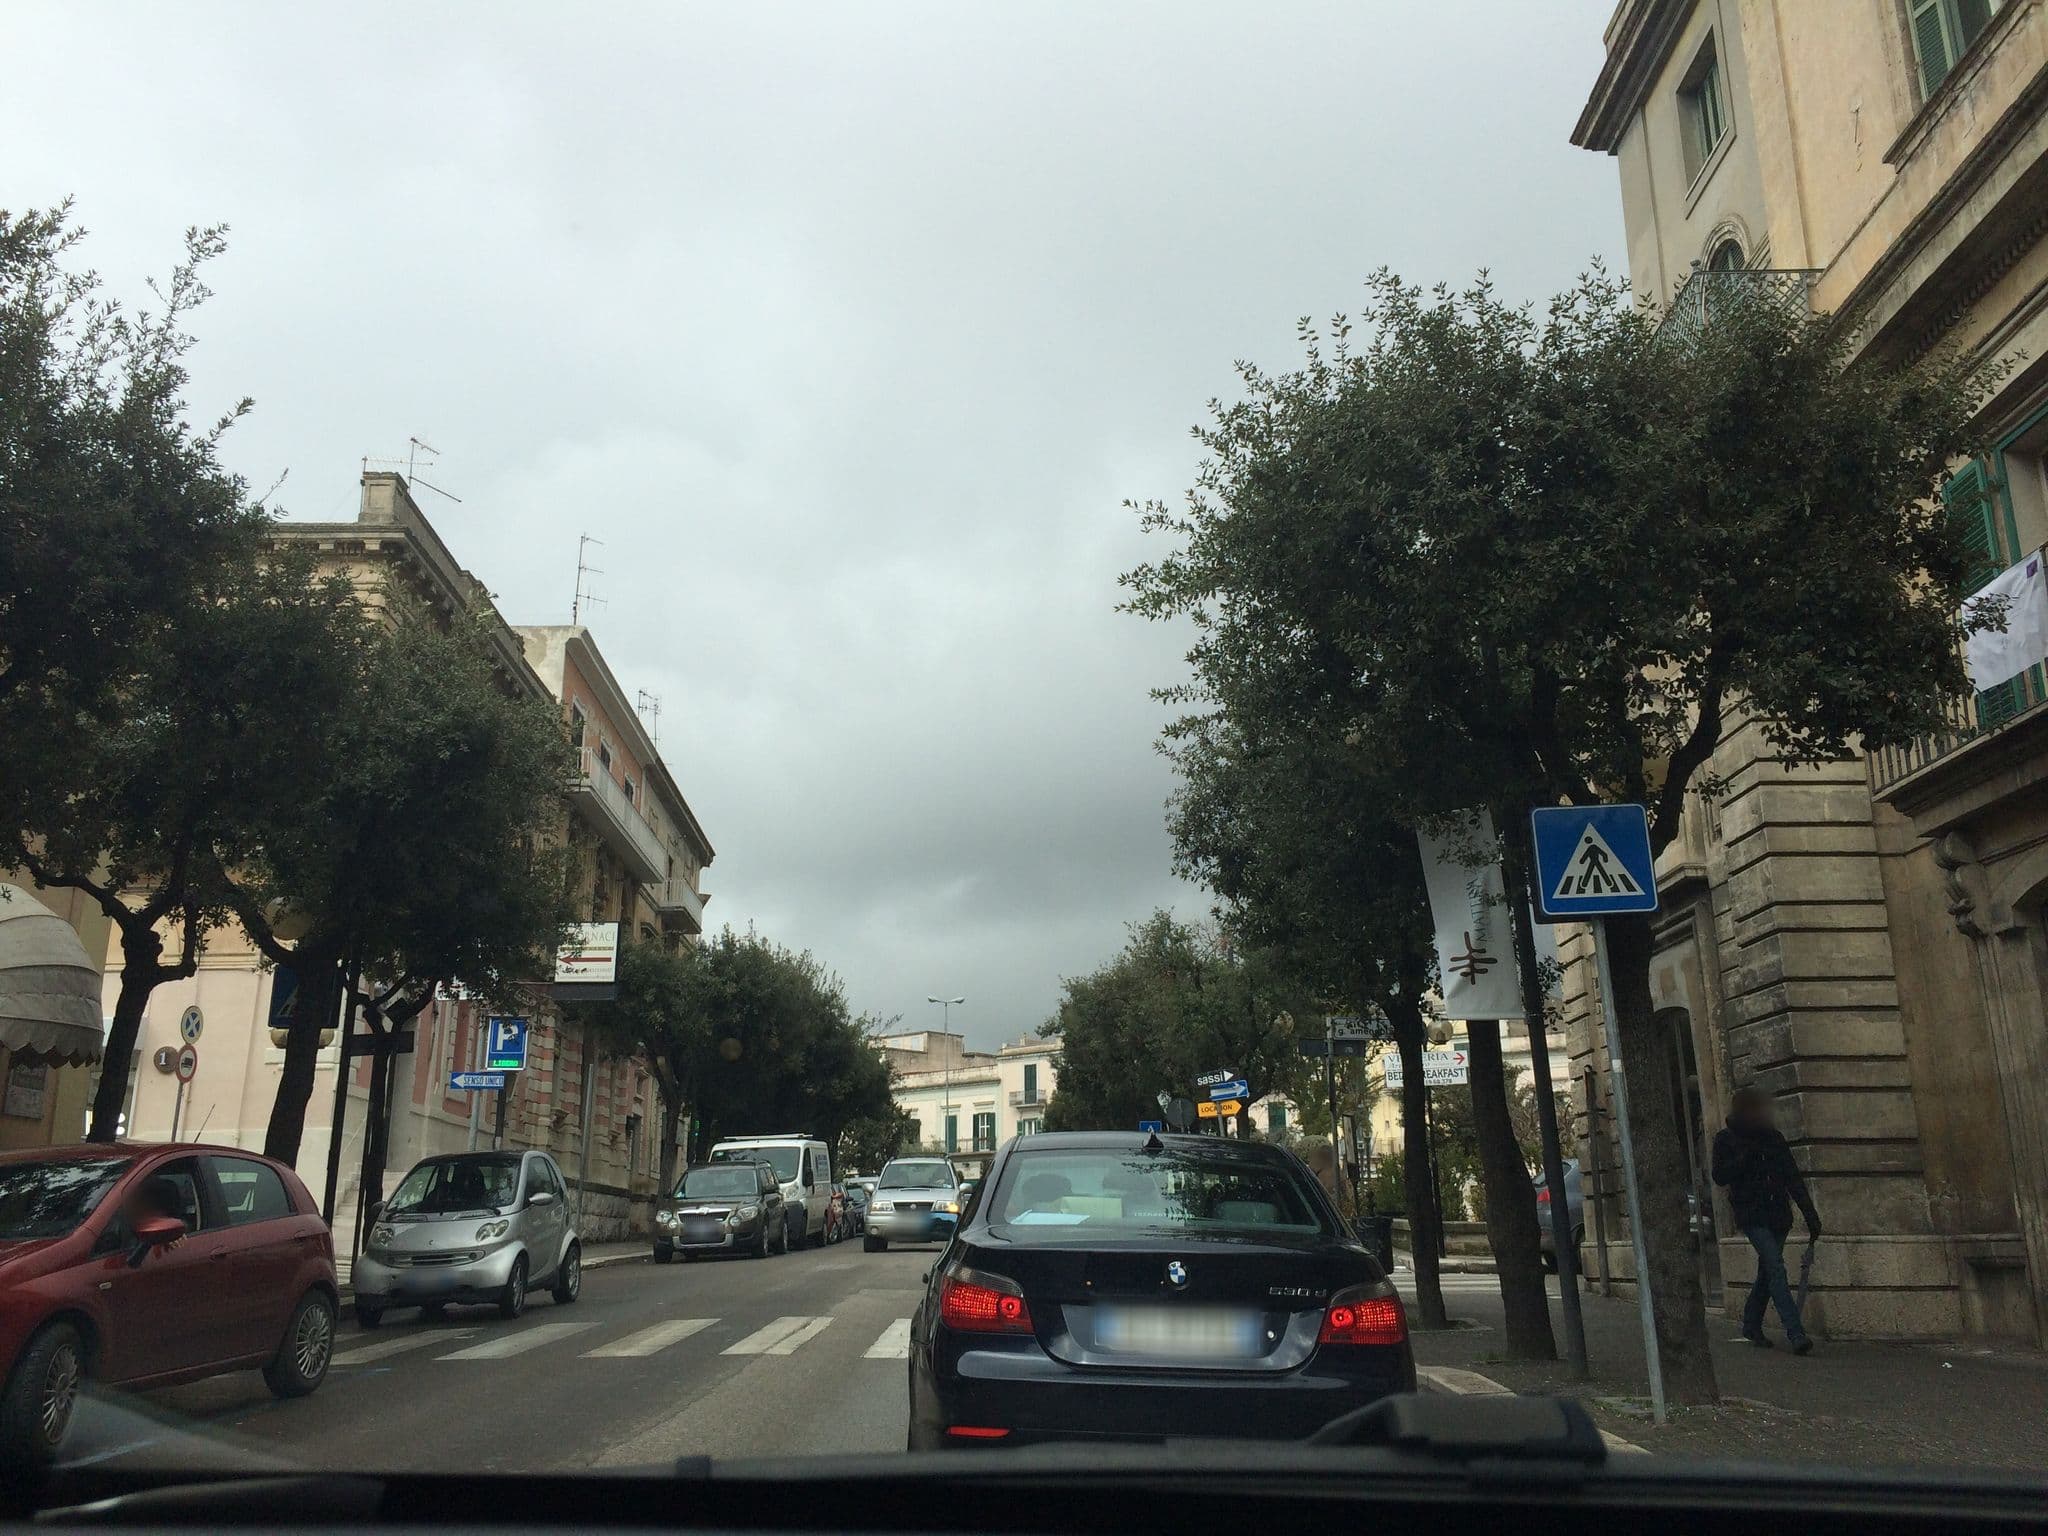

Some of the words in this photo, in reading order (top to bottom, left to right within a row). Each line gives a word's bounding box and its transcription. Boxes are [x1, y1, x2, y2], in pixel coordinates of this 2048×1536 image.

[159, 1051, 166, 1066] 1
[463, 1076, 484, 1086] SENSO
[485, 1076, 504, 1087] UNICO
[1196, 1070, 1224, 1086] sassi
[1201, 1103, 1234, 1113] LOCAION
